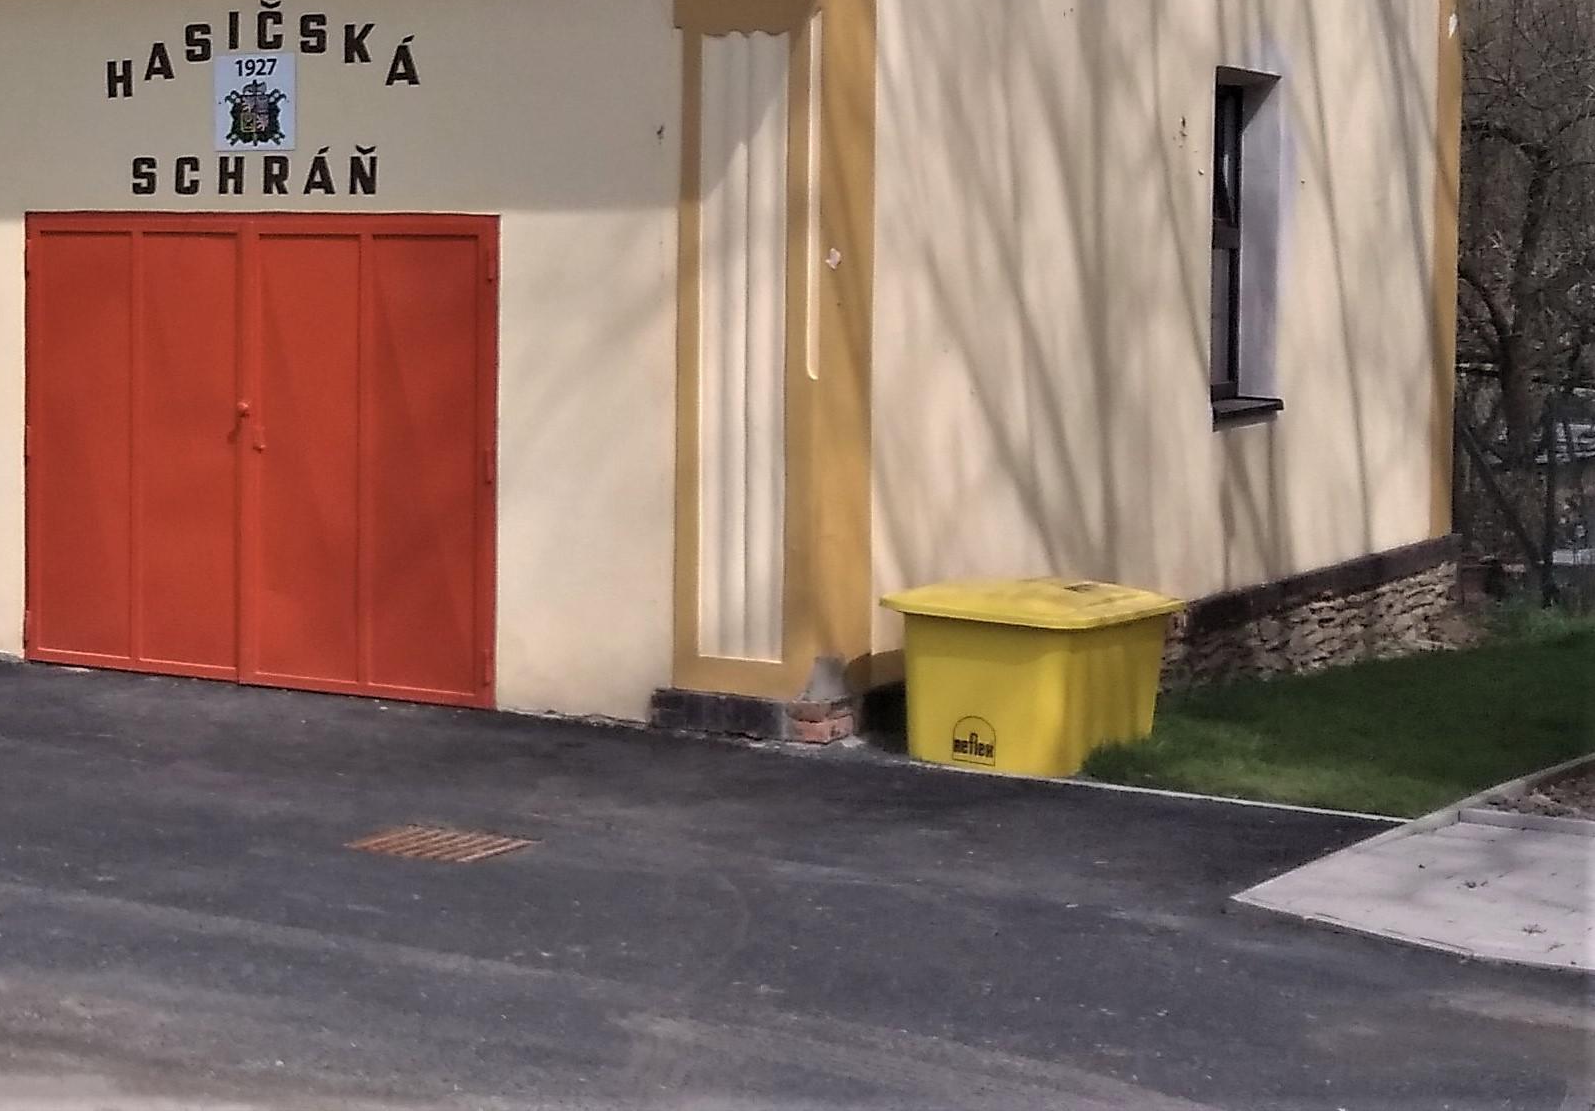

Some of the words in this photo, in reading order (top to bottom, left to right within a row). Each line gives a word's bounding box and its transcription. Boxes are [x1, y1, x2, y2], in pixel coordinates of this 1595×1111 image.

[106, 0, 420, 99] HASIČSKÁ
[235, 58, 277, 76] 1927
[132, 144, 378, 195] SCHRÁŇ
